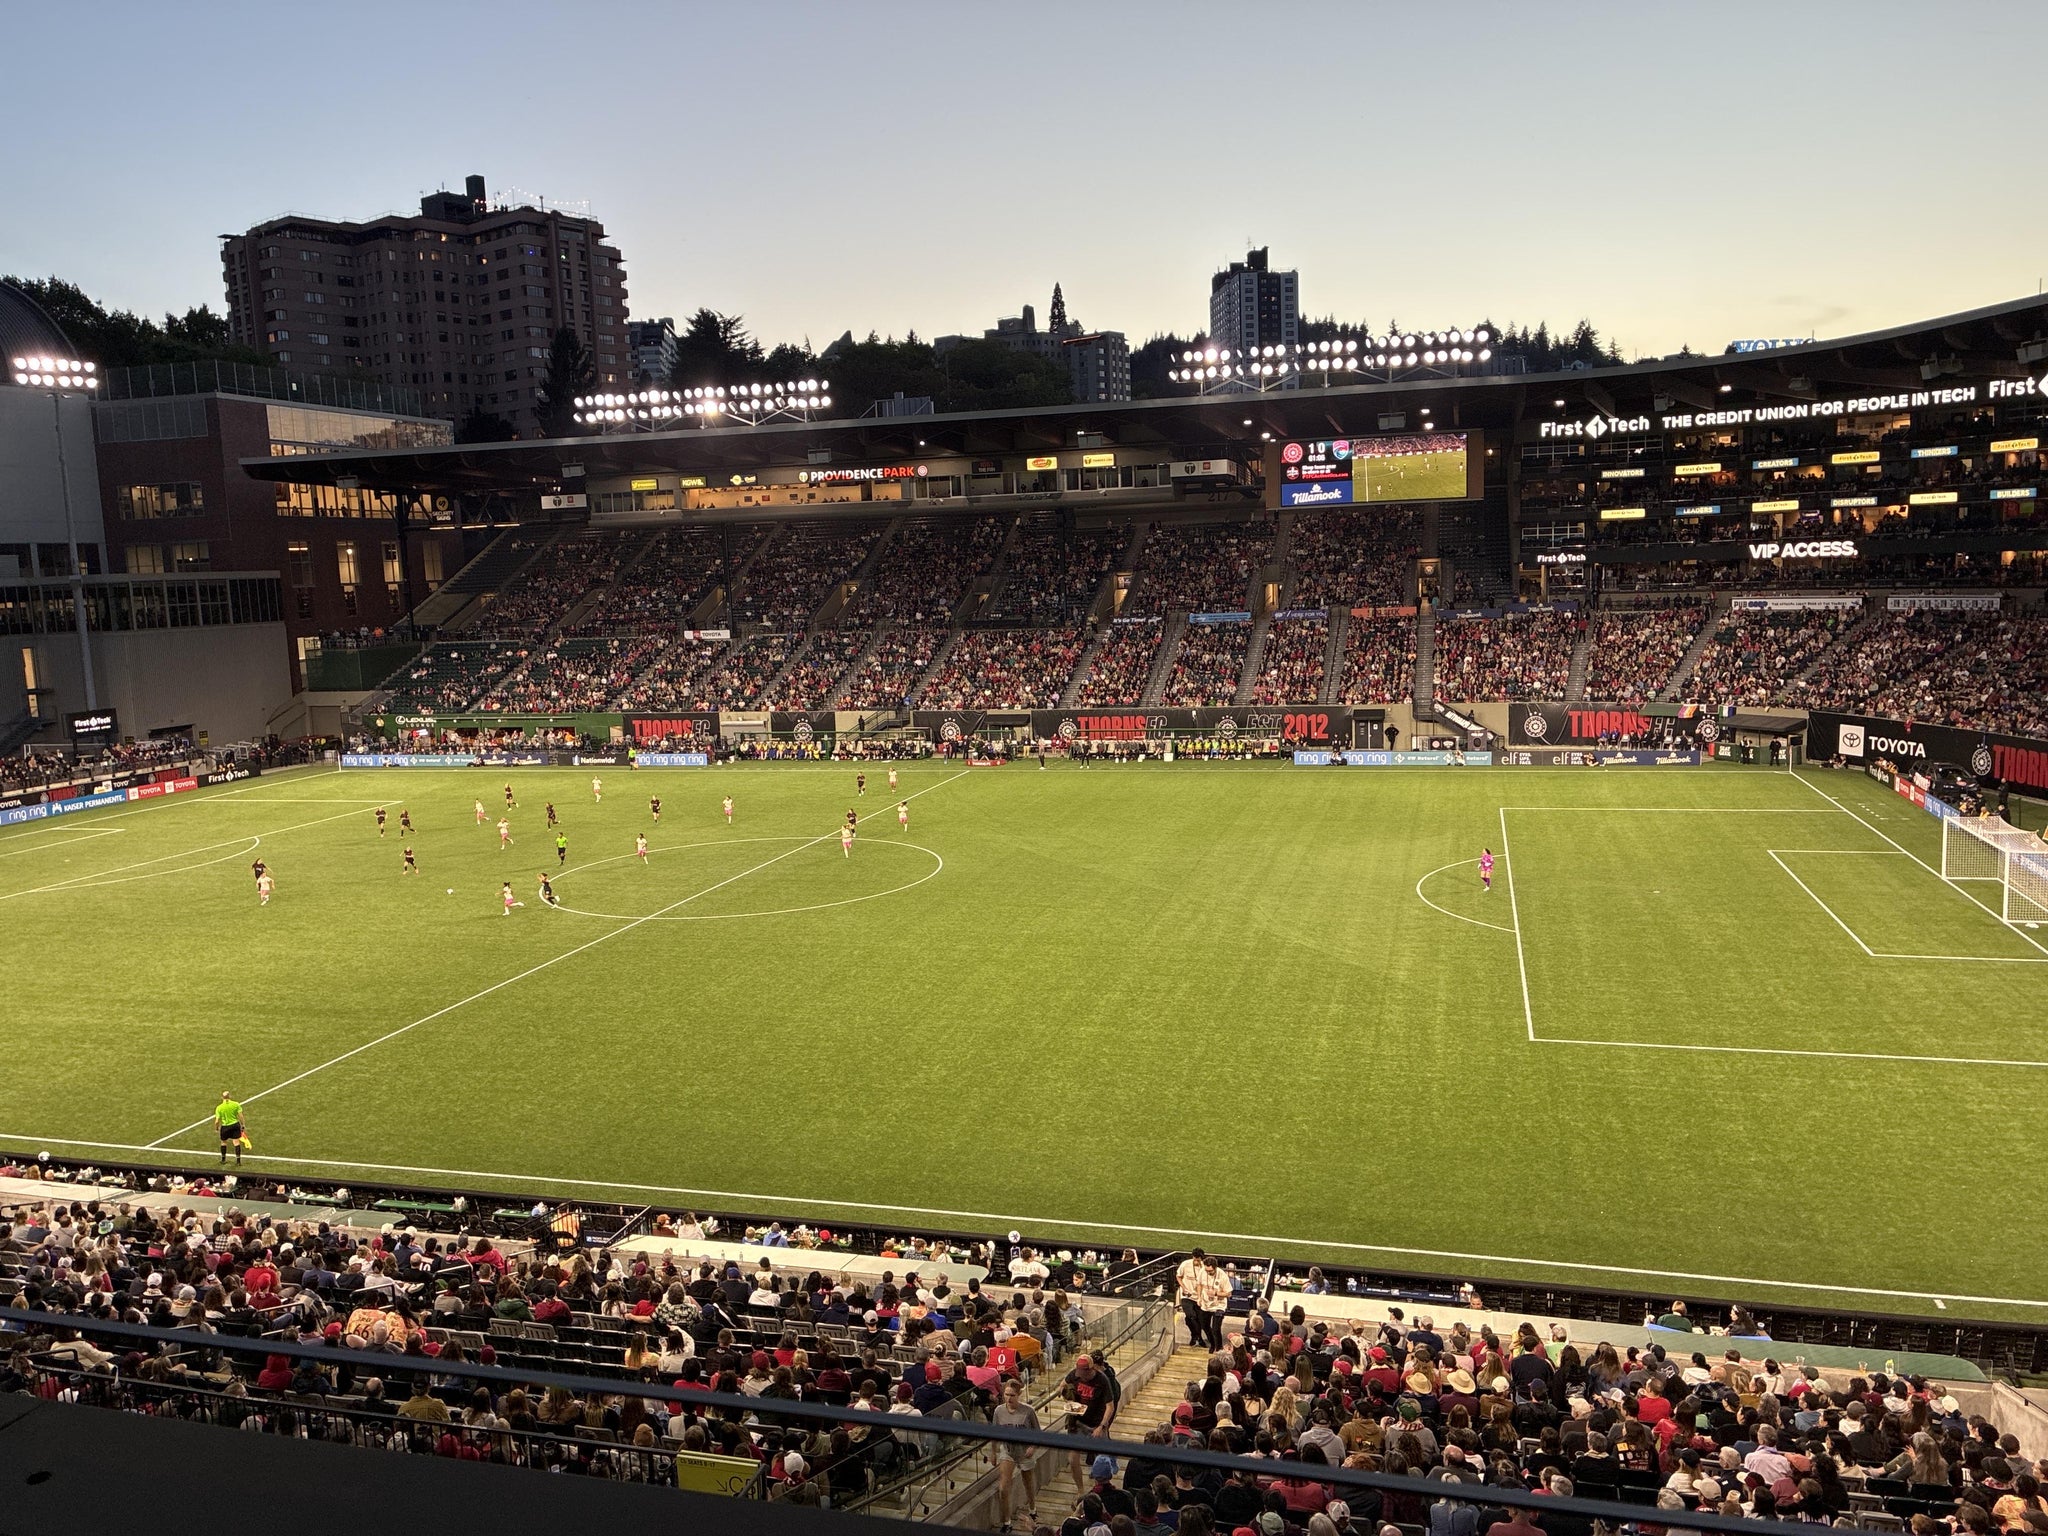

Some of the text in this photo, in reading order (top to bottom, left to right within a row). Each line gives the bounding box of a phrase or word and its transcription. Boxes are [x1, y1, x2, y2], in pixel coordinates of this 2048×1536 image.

[1732, 338, 1817, 353] VOL
[1989, 376, 2036, 398] First
[1662, 387, 1975, 429] THE CREDIT UNION FOR PEOPLE IN TECH
[1540, 416, 1650, 438] First Tech
[1309, 443, 1314, 454] 1
[1318, 443, 1325, 453] 0
[1917, 447, 1951, 457] THINKERS
[1757, 458, 1794, 468] CREATORS
[1602, 469, 1644, 478] INNOVATORS
[1292, 488, 1342, 505] Tillamook
[1996, 489, 2030, 498] BUILDERS
[1832, 497, 1876, 506] DISRUPTORS
[1749, 543, 1779, 559] VIP
[1537, 553, 1586, 563] First Tech
[1077, 716, 1146, 741] THORNS
[1246, 714, 1282, 739] EST
[1283, 713, 1329, 740] 2012
[1568, 710, 1651, 738] THORNS
[632, 719, 692, 741] THORNS
[1868, 736, 1926, 758] TOYOTA
[343, 756, 357, 766] ring
[359, 756, 373, 766] ring
[653, 755, 668, 766] ring
[670, 755, 686, 766] ring
[688, 755, 704, 766] ring
[1299, 753, 1318, 764] ring
[1367, 753, 1387, 765] ring
[1501, 752, 1518, 765] elf
[1552, 752, 1570, 765] elf
[1602, 755, 1638, 765] Tillamook
[1655, 755, 1691, 765] Tillamook
[208, 769, 249, 783] First Tech
[113, 780, 130, 788] TOYO
[175, 780, 196, 789] TOYOTA
[139, 786, 161, 795] TOYOTA
[29, 804, 47, 817] ring
[63, 803, 84, 811] KAISER
[9, 810, 27, 822] ring
[997, 1353, 1006, 1365] 0
